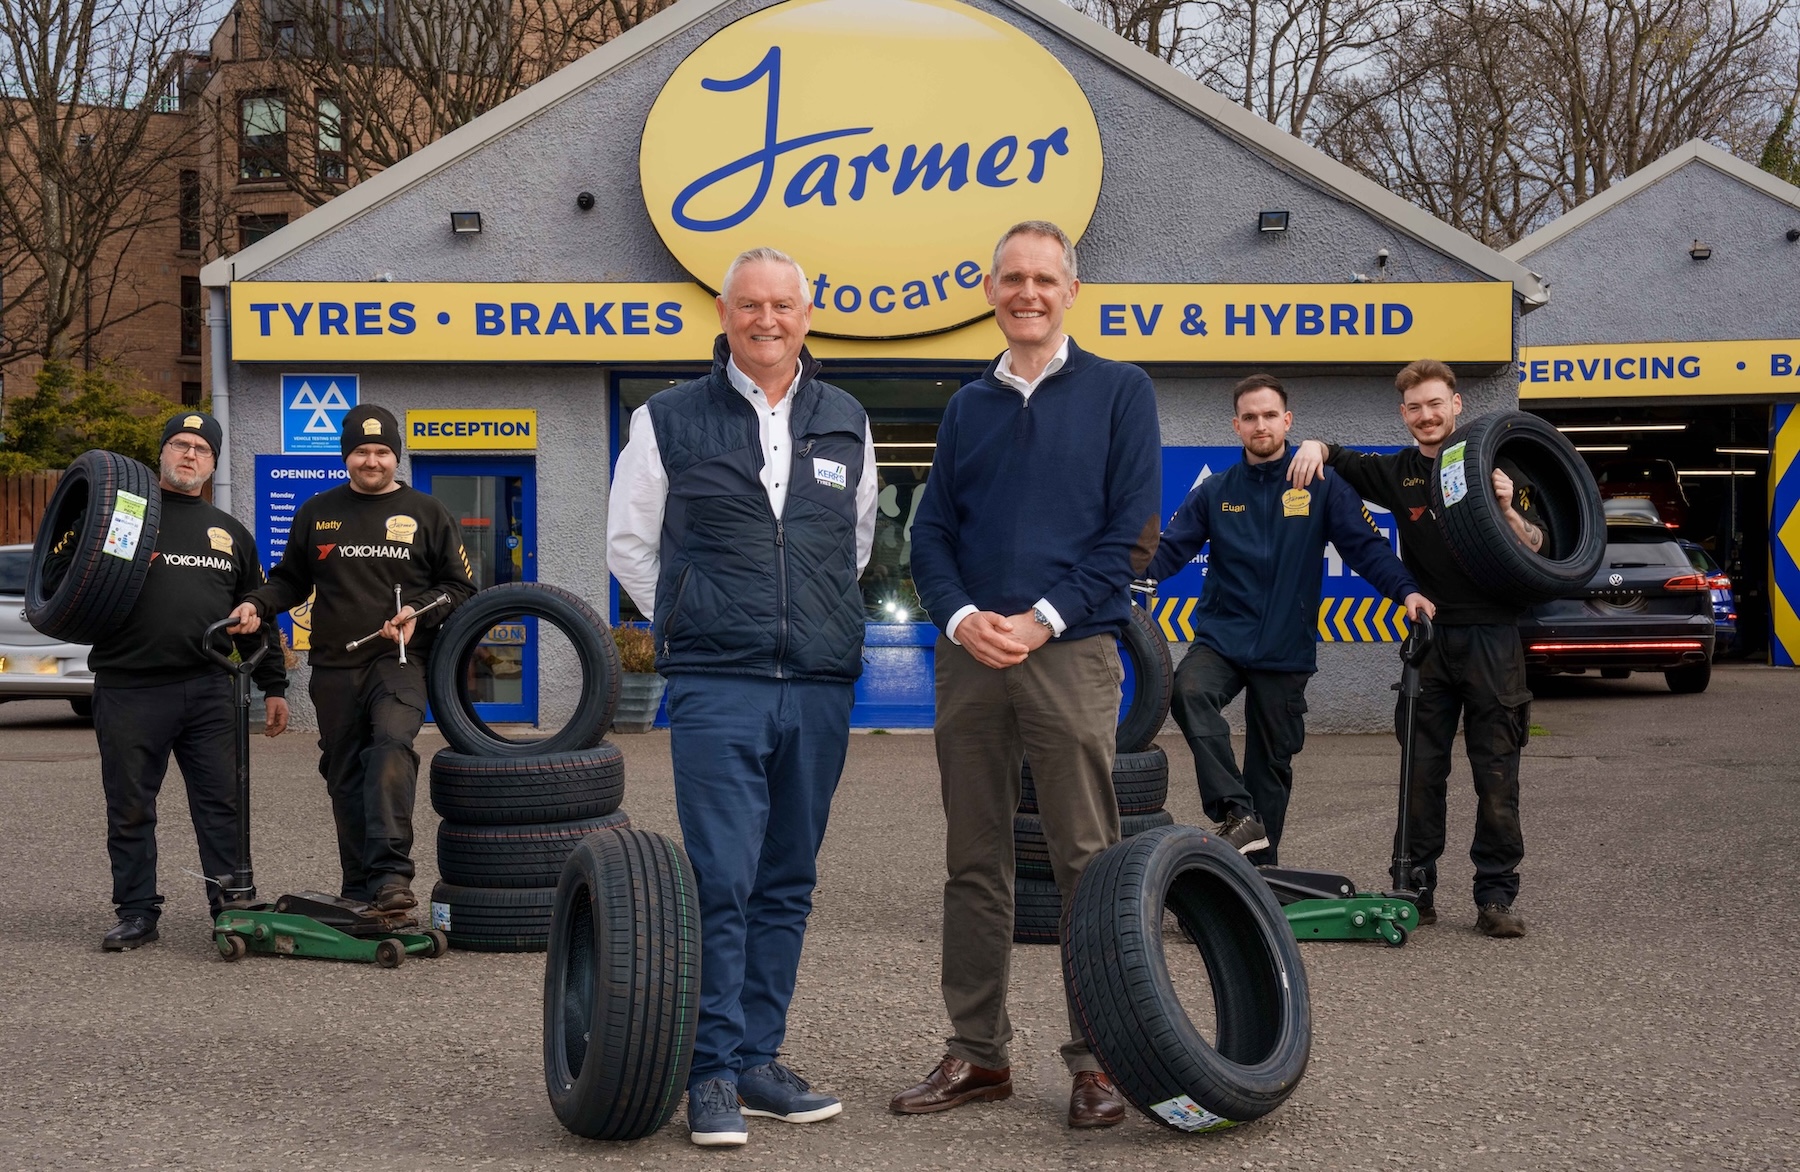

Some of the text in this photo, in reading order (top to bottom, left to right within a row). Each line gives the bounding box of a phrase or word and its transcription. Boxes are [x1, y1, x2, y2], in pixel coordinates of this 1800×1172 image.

[807, 260, 983, 314] tocare
[250, 302, 684, 337] TYRES BRAKES
[1100, 303, 1414, 337] EV & HYBRID
[1770, 353, 1800, 377] B
[413, 421, 530, 437] RECEPTION
[270, 469, 325, 479] OPENING
[270, 492, 295, 500] Monday
[270, 503, 296, 511] Tuesday
[1221, 502, 1246, 513] Euan
[315, 520, 343, 531] Matty
[338, 545, 411, 560] YOKOHAMA
[162, 553, 232, 572] YOKOHAMA
